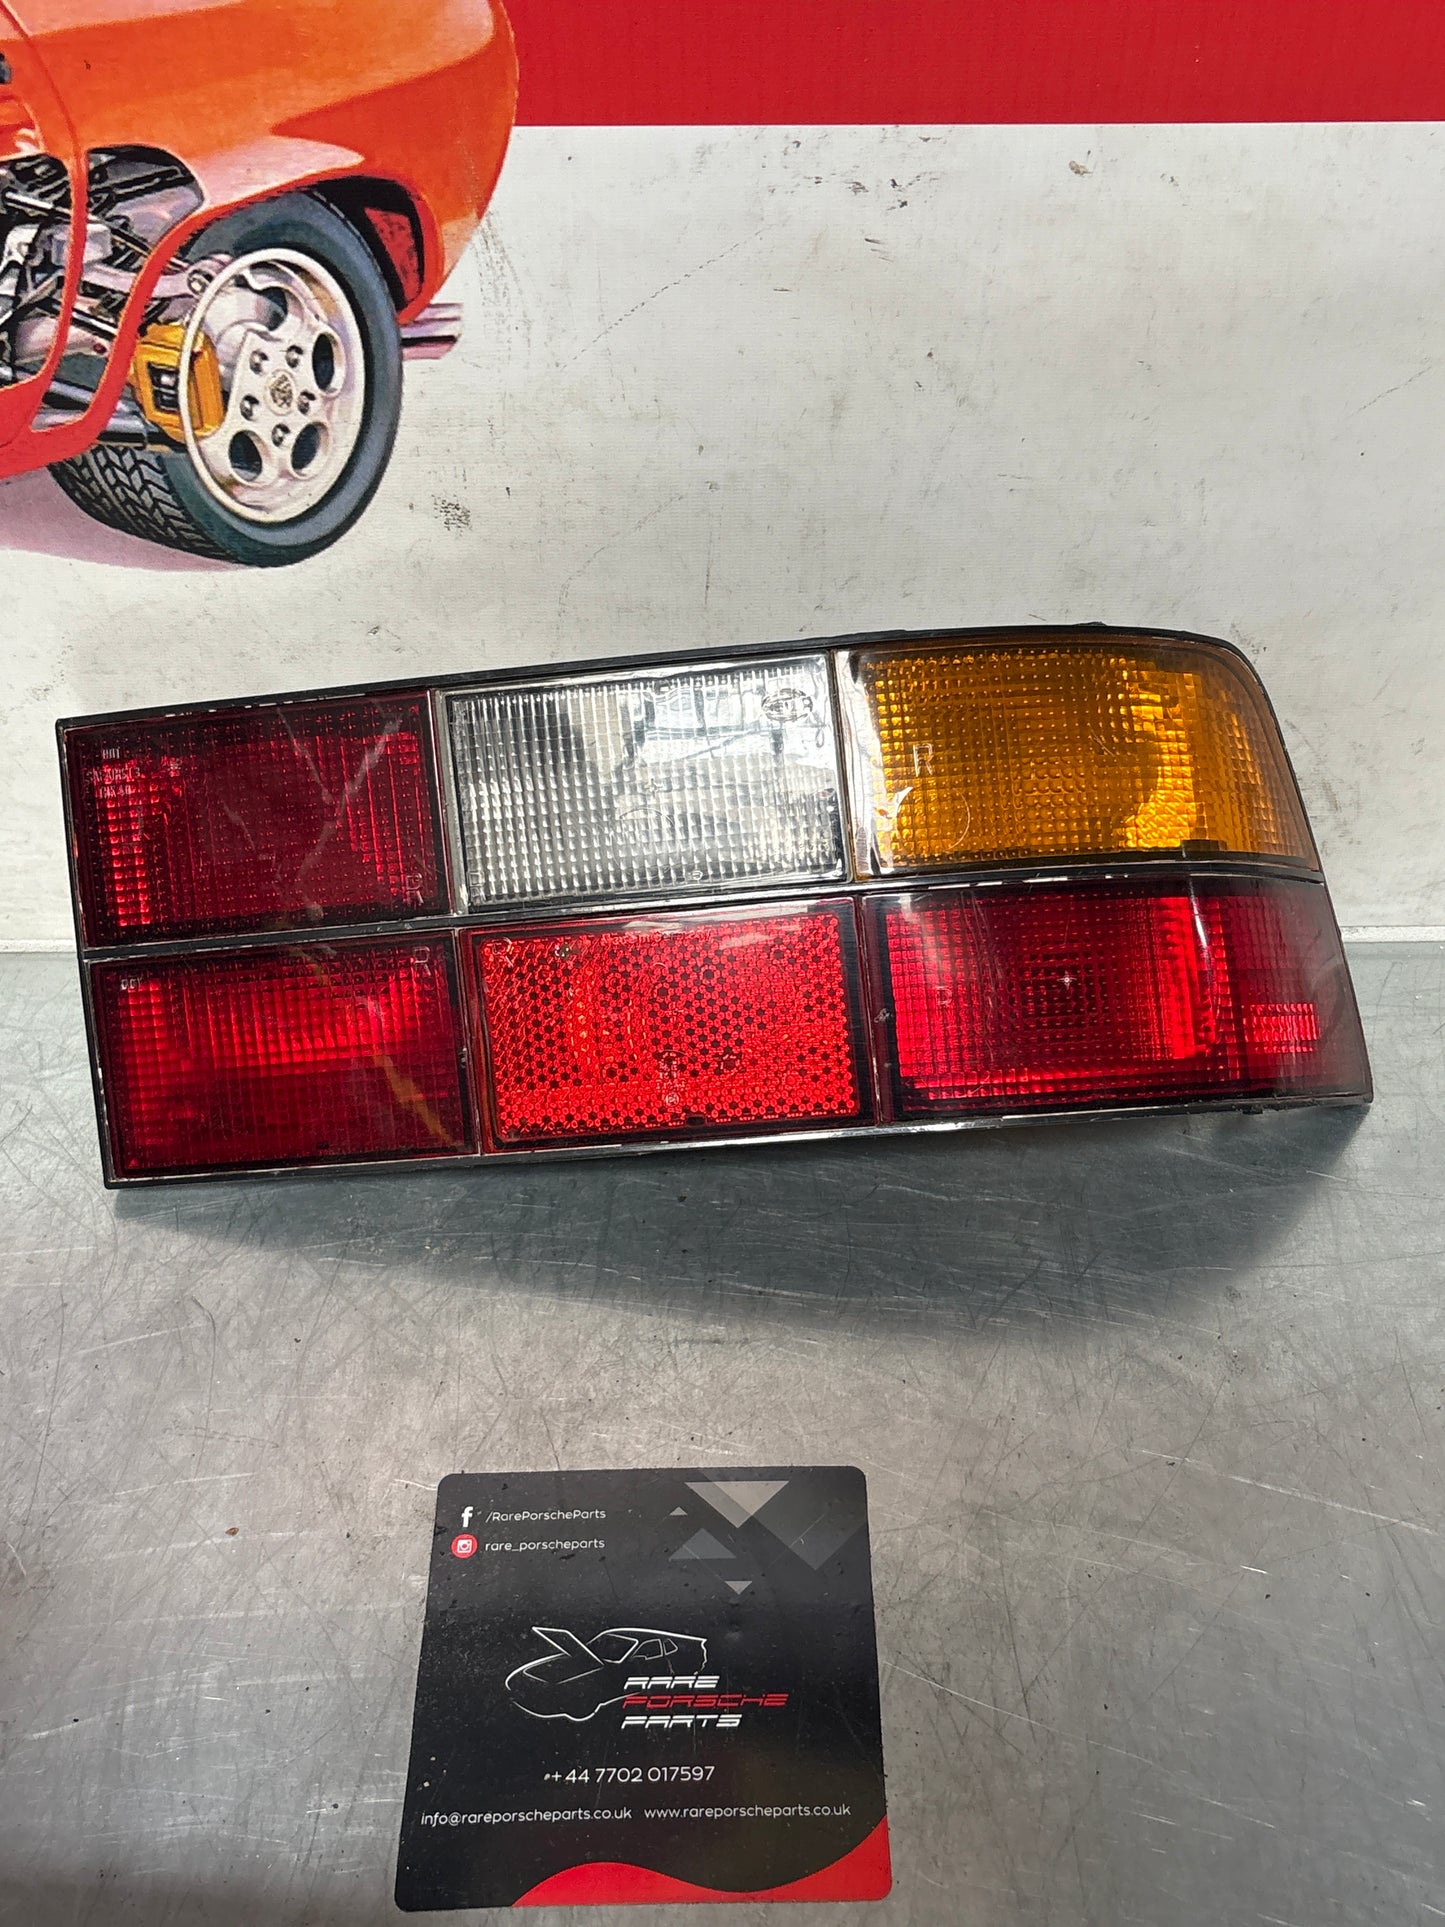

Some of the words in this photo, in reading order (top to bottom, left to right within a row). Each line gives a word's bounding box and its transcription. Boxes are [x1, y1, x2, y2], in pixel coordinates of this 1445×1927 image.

[913, 743, 934, 777] R
[485, 1508, 607, 1523] /RarePorscheParts
[485, 1538, 605, 1552] rare_porscheparts
[623, 1675, 720, 1690] RARE
[622, 1693, 789, 1710] PORSCHE
[620, 1714, 743, 1730] PARTS
[595, 1766, 643, 1784] 7702
[647, 1765, 716, 1782] 017597
[420, 1806, 633, 1828] info@rareporscheparts.co.uk
[644, 1803, 852, 1820] www.rareporscheparts.co.uk
